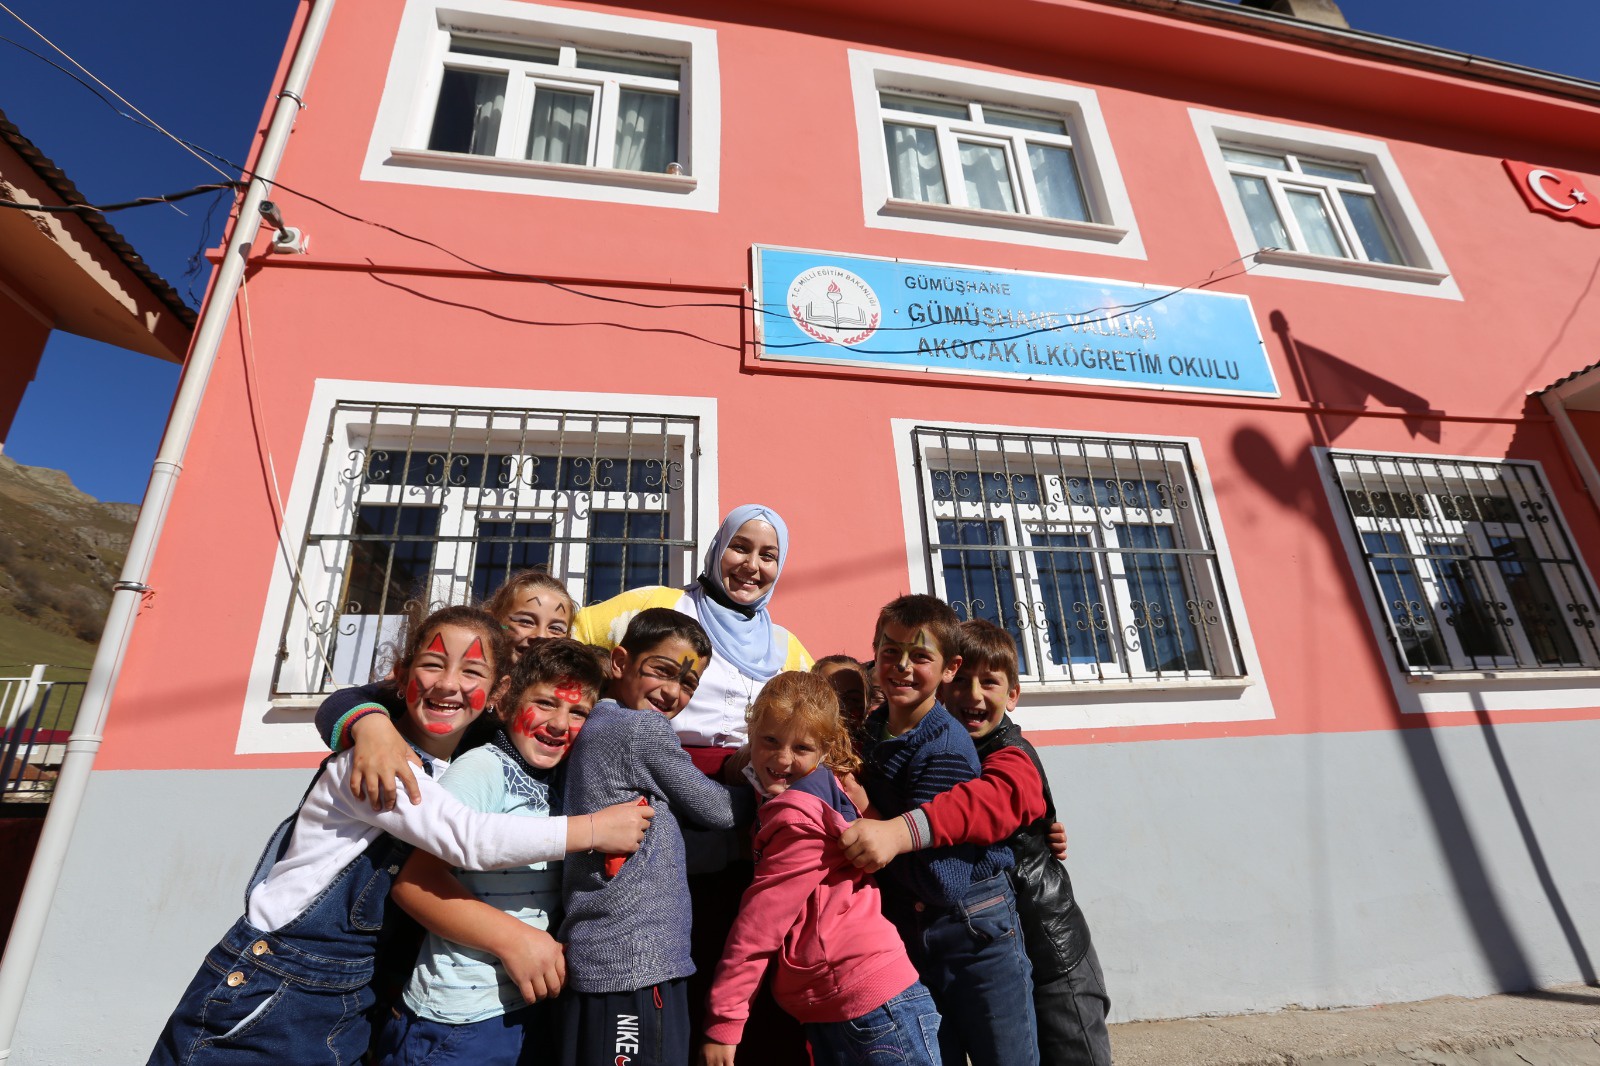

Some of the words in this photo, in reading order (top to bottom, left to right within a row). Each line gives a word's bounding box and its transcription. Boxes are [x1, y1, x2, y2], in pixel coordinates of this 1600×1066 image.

[798, 271, 817, 287] MİLLİ
[817, 268, 844, 278] EĞİTİM
[904, 274, 1011, 296] GÜMÜŞHANE
[908, 300, 1062, 332] GÜMÜŞHANE
[917, 337, 1021, 363] AKOCAK
[1025, 339, 1164, 375] İLKÖĞRETİM
[1168, 354, 1240, 381] OKULU
[616, 1014, 639, 1054] NIKE
